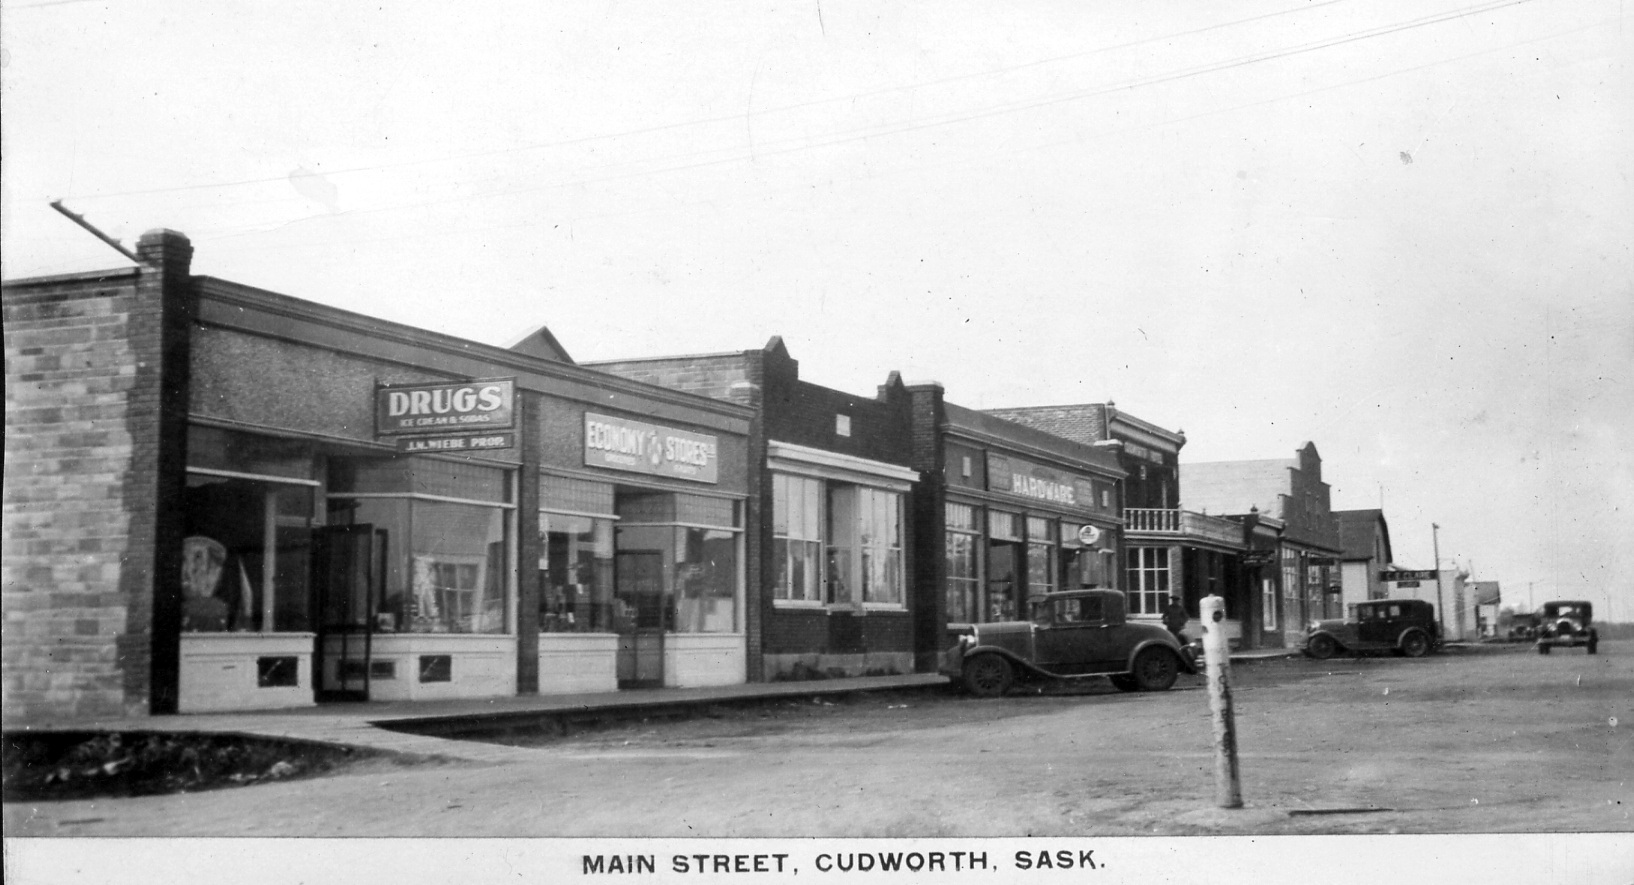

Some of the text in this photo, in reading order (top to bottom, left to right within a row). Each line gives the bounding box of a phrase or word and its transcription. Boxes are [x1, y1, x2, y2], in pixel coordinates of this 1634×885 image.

[389, 386, 502, 417] DRUGS
[587, 421, 645, 456] ECONOMY
[665, 436, 708, 466] STORES
[1013, 473, 1076, 505] HARDWARE
